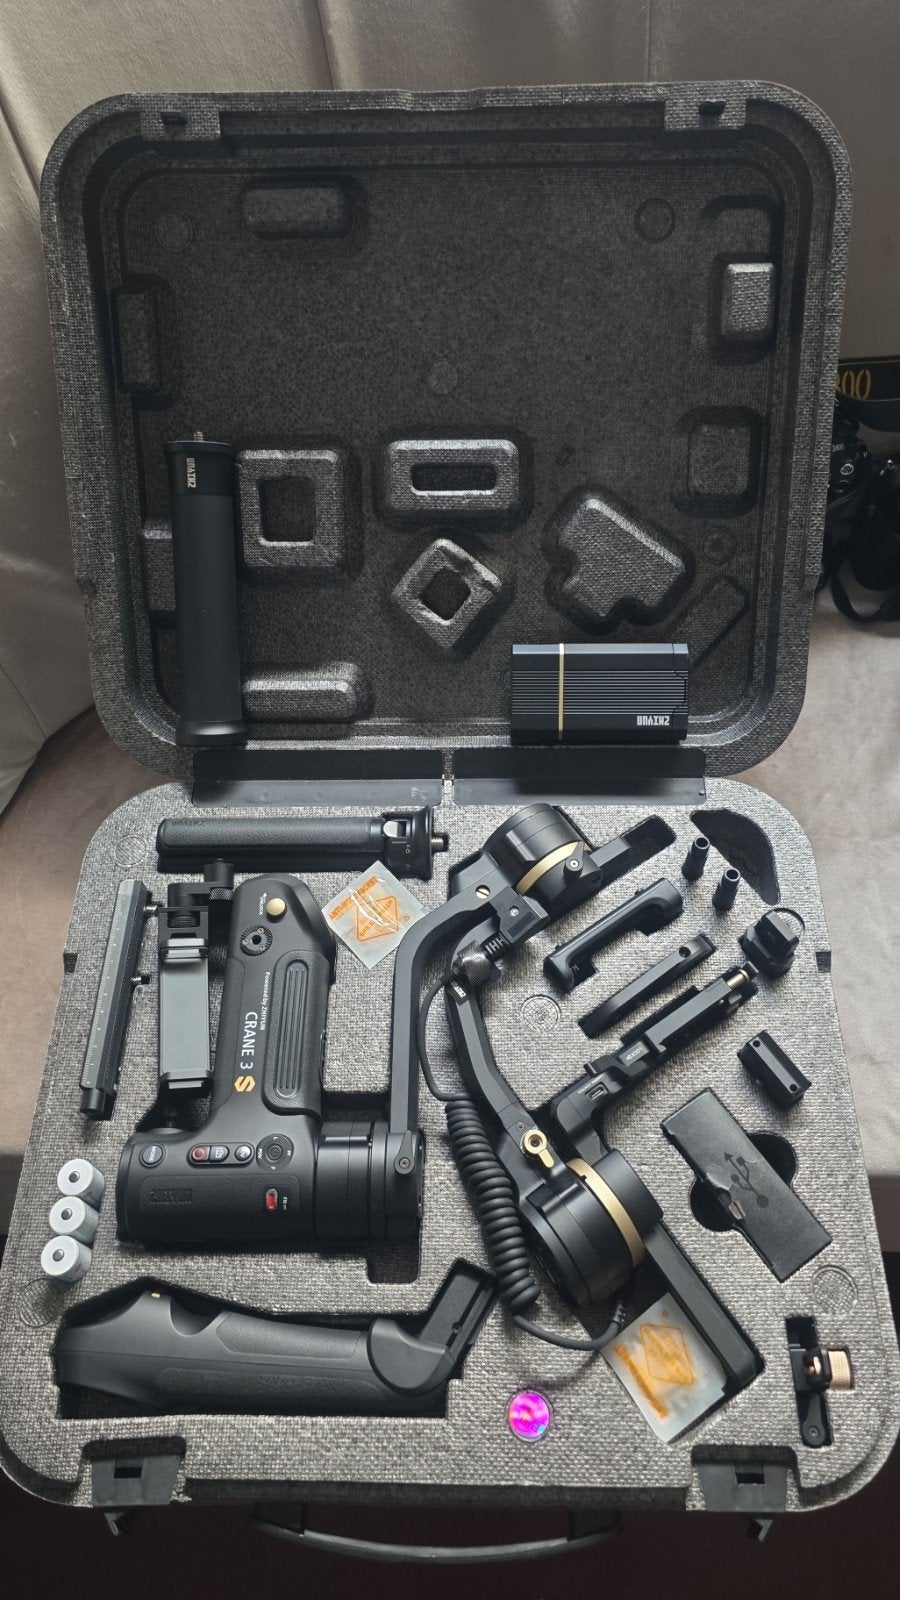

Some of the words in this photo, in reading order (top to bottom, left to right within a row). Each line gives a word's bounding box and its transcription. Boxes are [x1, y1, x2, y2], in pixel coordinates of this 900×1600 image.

[186, 458, 197, 488] ZHIYUN
[636, 715, 670, 726] ZHIYUN
[260, 1006, 268, 1031] ZHIYUN
[241, 1011, 258, 1057] CRANE
[240, 1061, 254, 1070] 3
